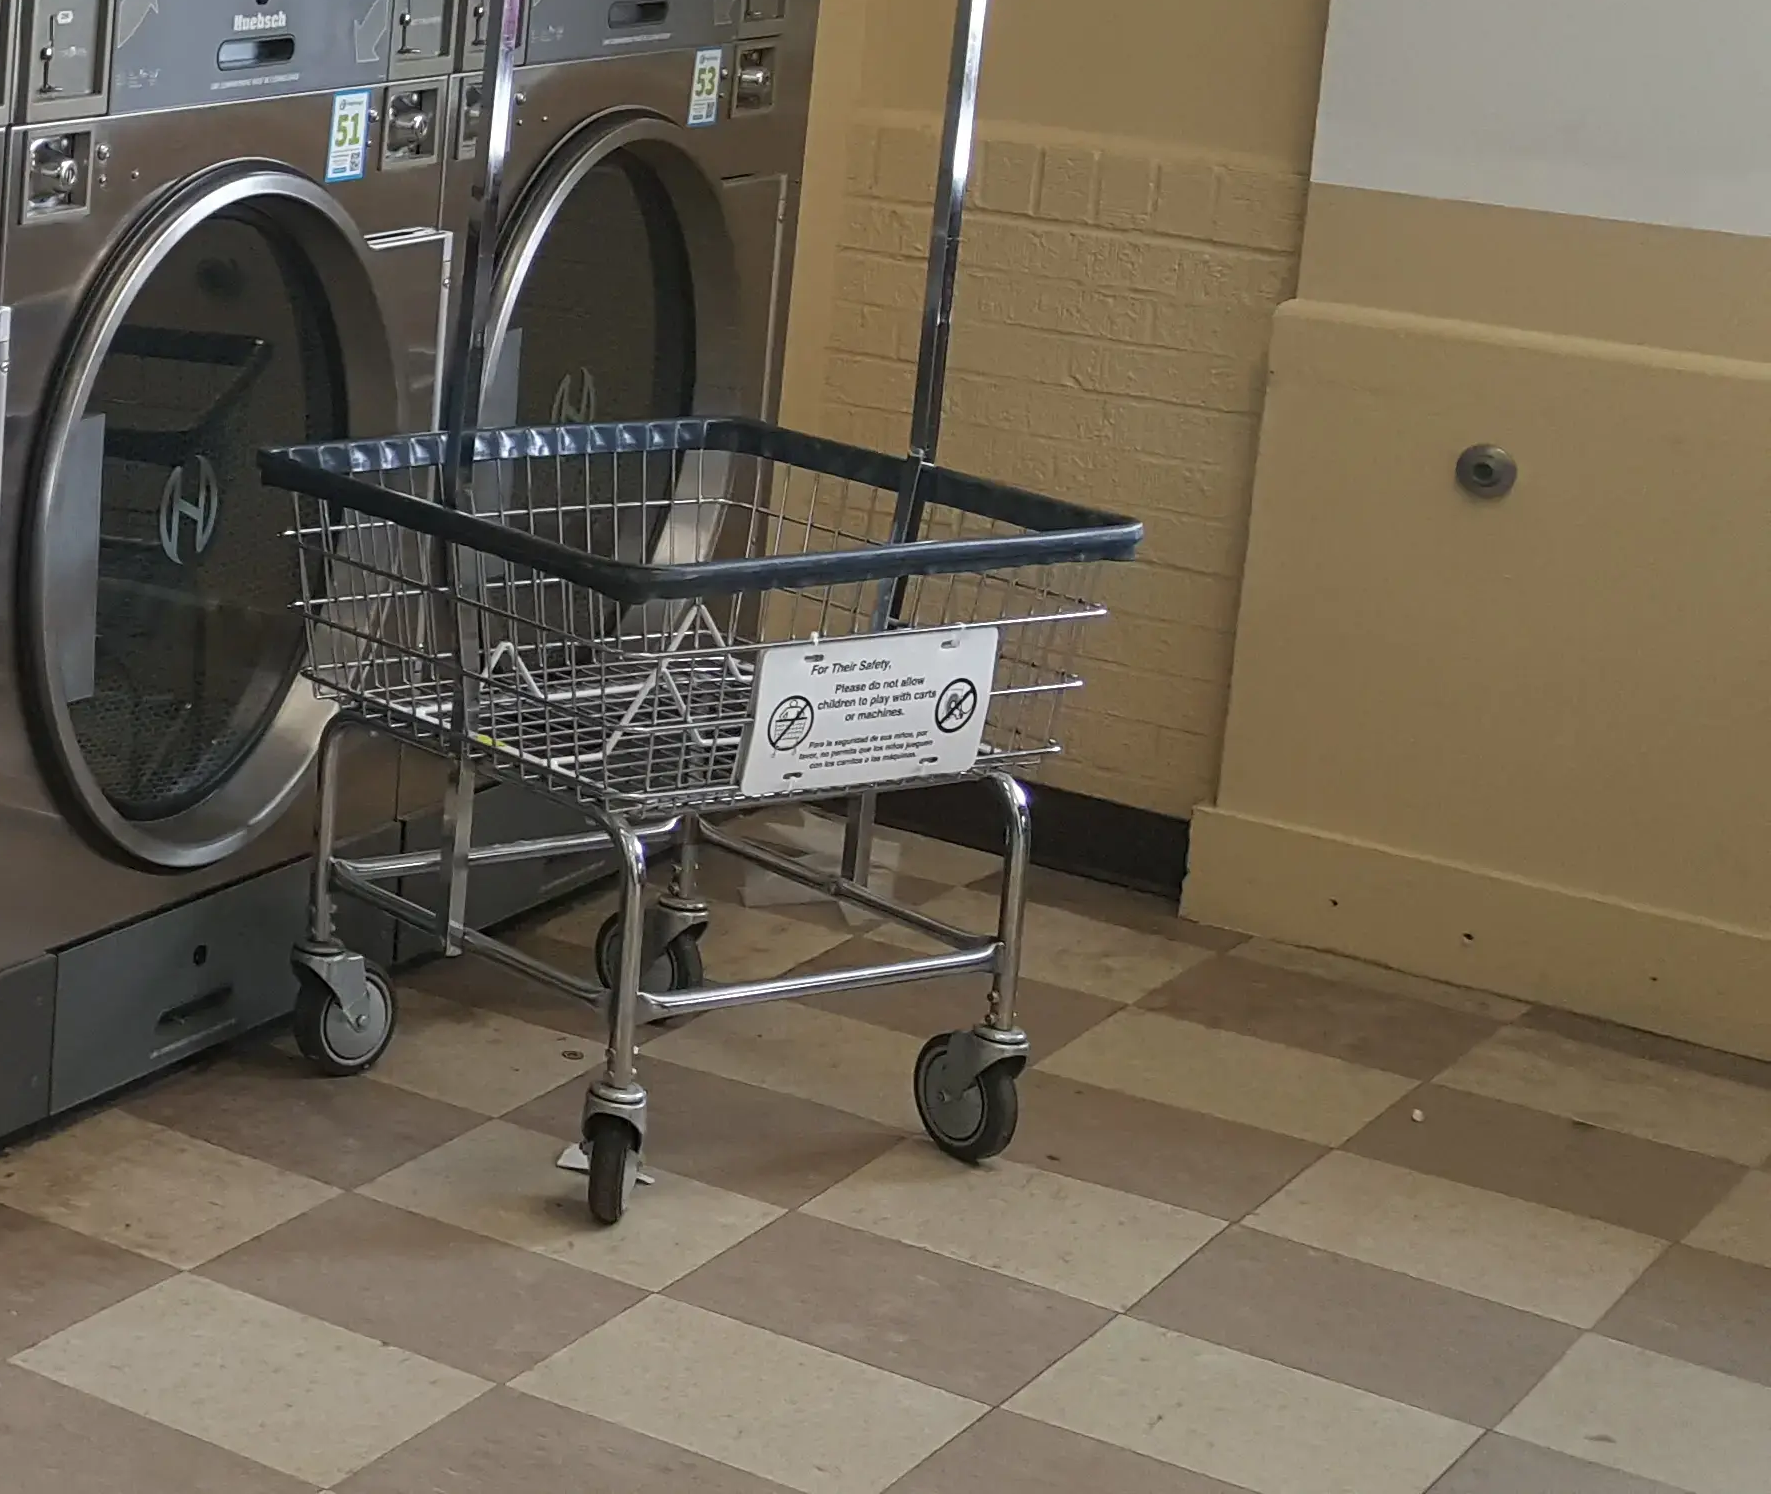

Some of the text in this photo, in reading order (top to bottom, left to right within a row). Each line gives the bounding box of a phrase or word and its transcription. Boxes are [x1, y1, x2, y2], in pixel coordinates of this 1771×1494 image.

[233, 10, 287, 31] Huebsch
[695, 66, 716, 97] 53
[335, 113, 360, 147] 51
[811, 660, 892, 675] For Their Safety,
[835, 677, 925, 694] Please do not allow
[817, 690, 936, 710] children to play with carts
[858, 708, 904, 720] machines.
